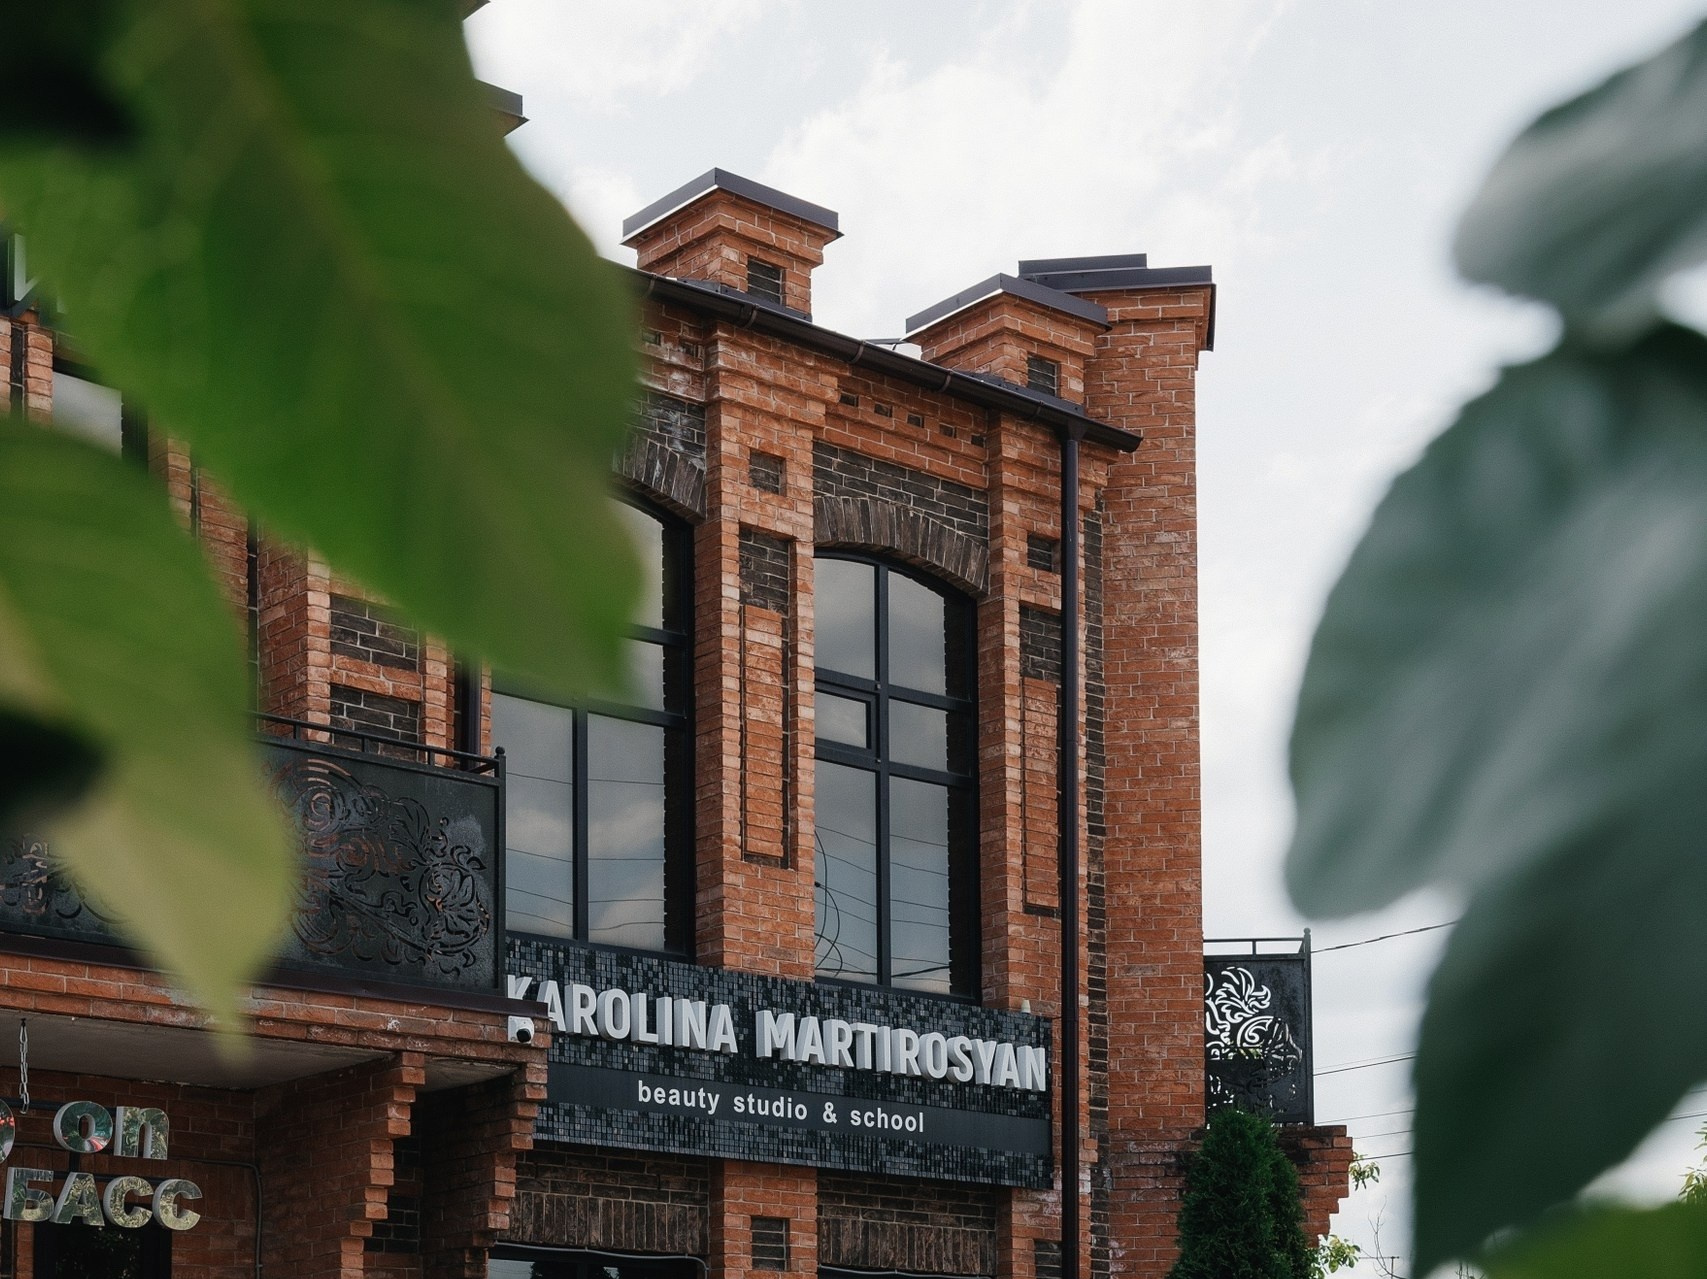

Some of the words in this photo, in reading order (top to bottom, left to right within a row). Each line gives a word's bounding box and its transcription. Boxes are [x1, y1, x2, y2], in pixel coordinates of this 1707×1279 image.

[755, 1009, 1046, 1092] MARTIROSYAN
[638, 1080, 720, 1115] beauty
[733, 1094, 808, 1121] studio
[822, 1101, 838, 1124] &
[850, 1108, 924, 1133] school
[3, 1167, 202, 1231] БАСС
